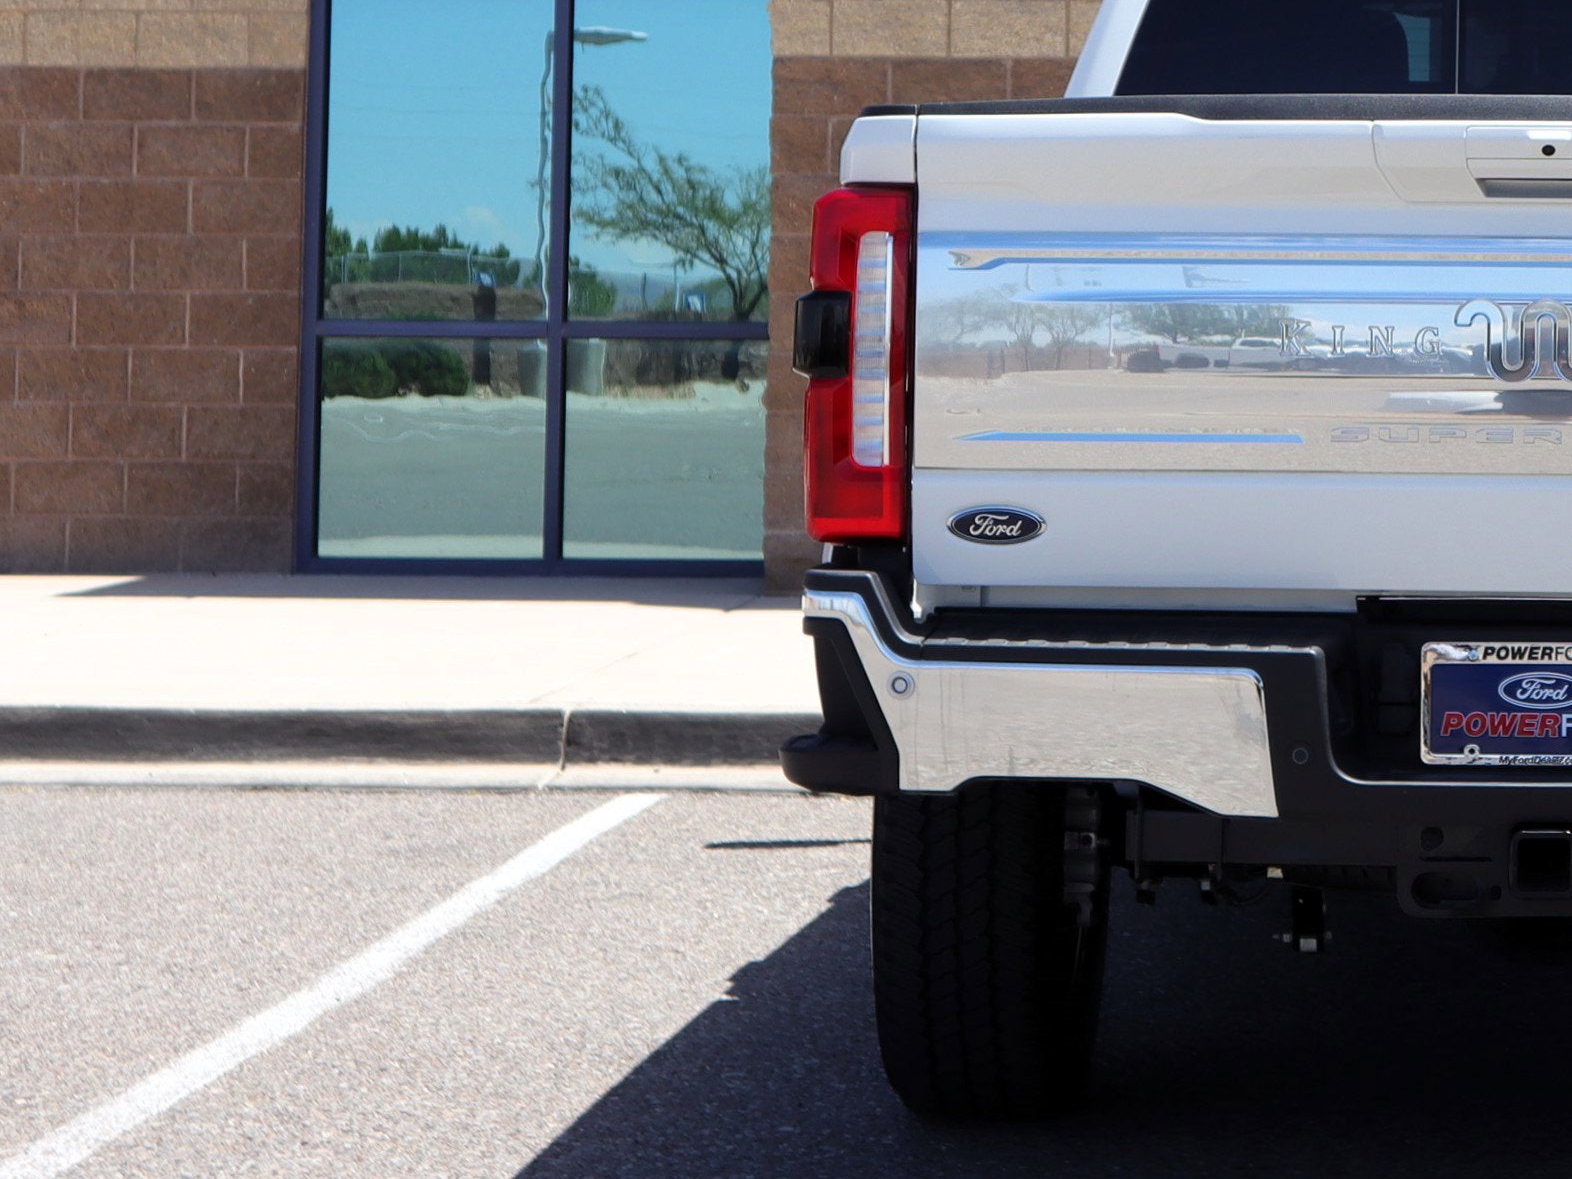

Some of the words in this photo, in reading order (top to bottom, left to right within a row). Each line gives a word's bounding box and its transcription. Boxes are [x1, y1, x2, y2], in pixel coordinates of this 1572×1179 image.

[1279, 320, 1442, 358] KING
[1330, 425, 1563, 445] SUPER
[970, 514, 1022, 536] Ford
[1516, 678, 1569, 701] Ford
